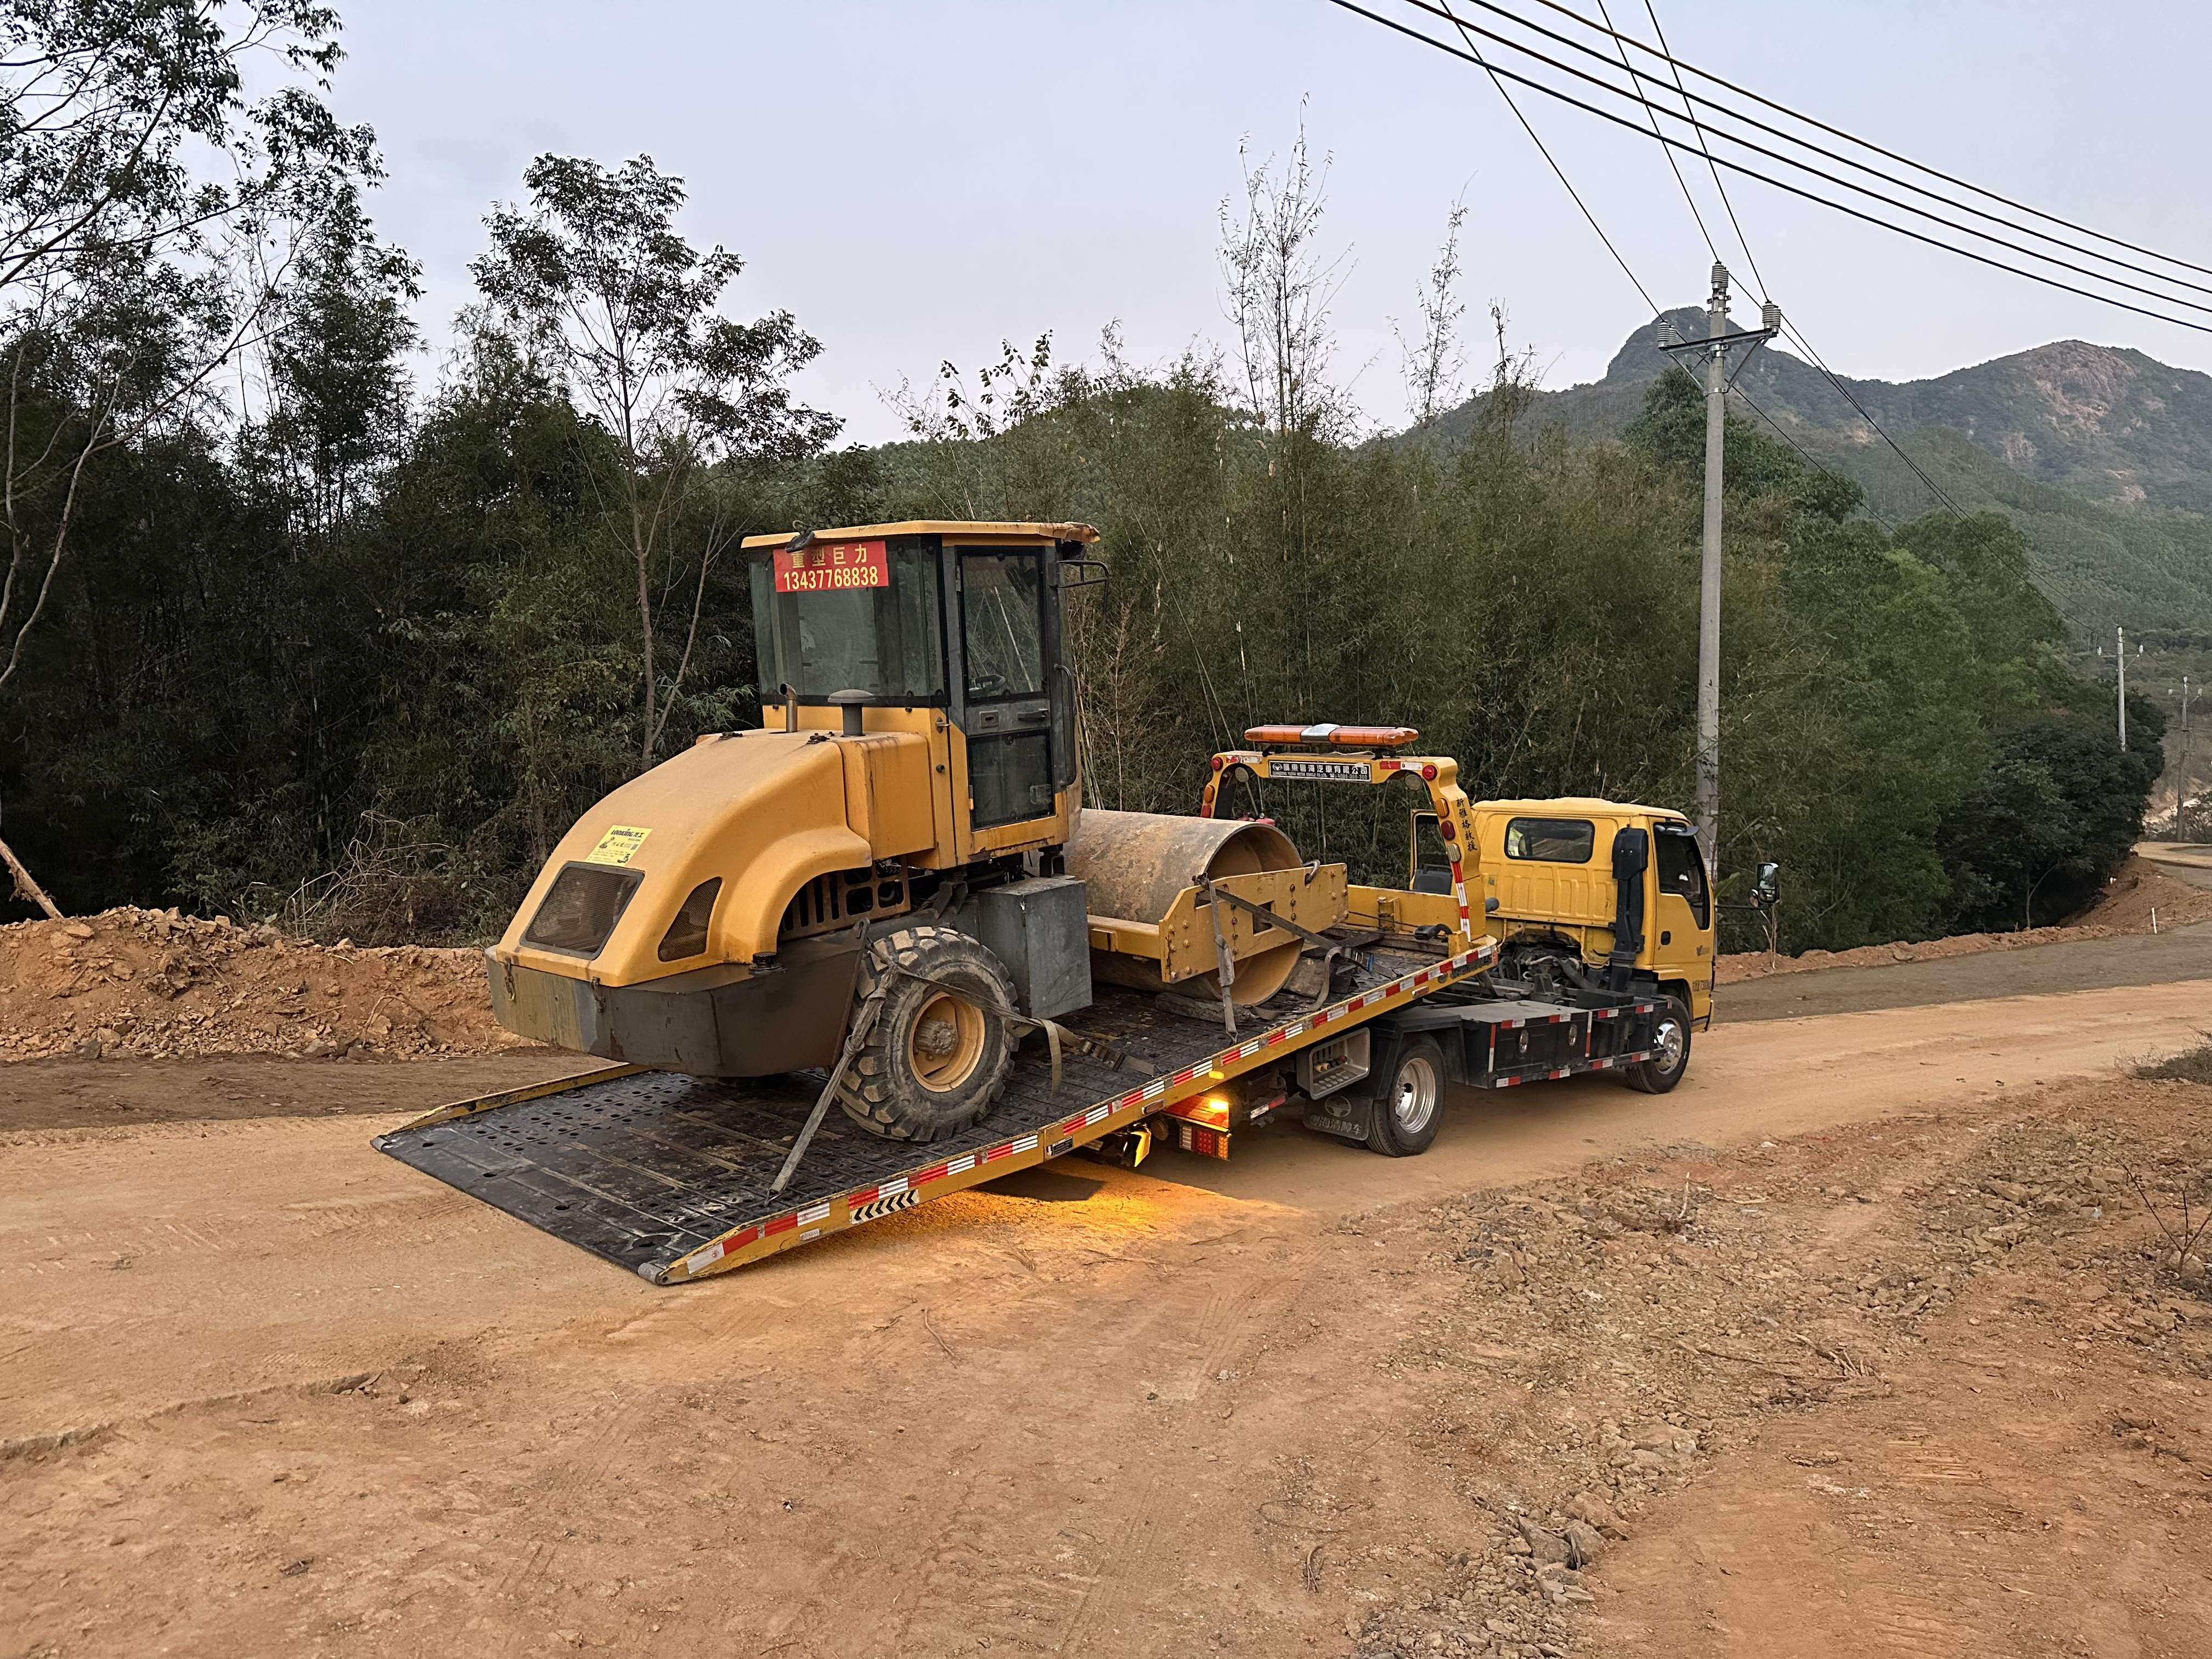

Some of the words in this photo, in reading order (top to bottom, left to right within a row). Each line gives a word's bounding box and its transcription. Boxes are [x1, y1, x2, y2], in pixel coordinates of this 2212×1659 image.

[791, 544, 867, 568] 重型巨力
[783, 566, 878, 590] 13437768838
